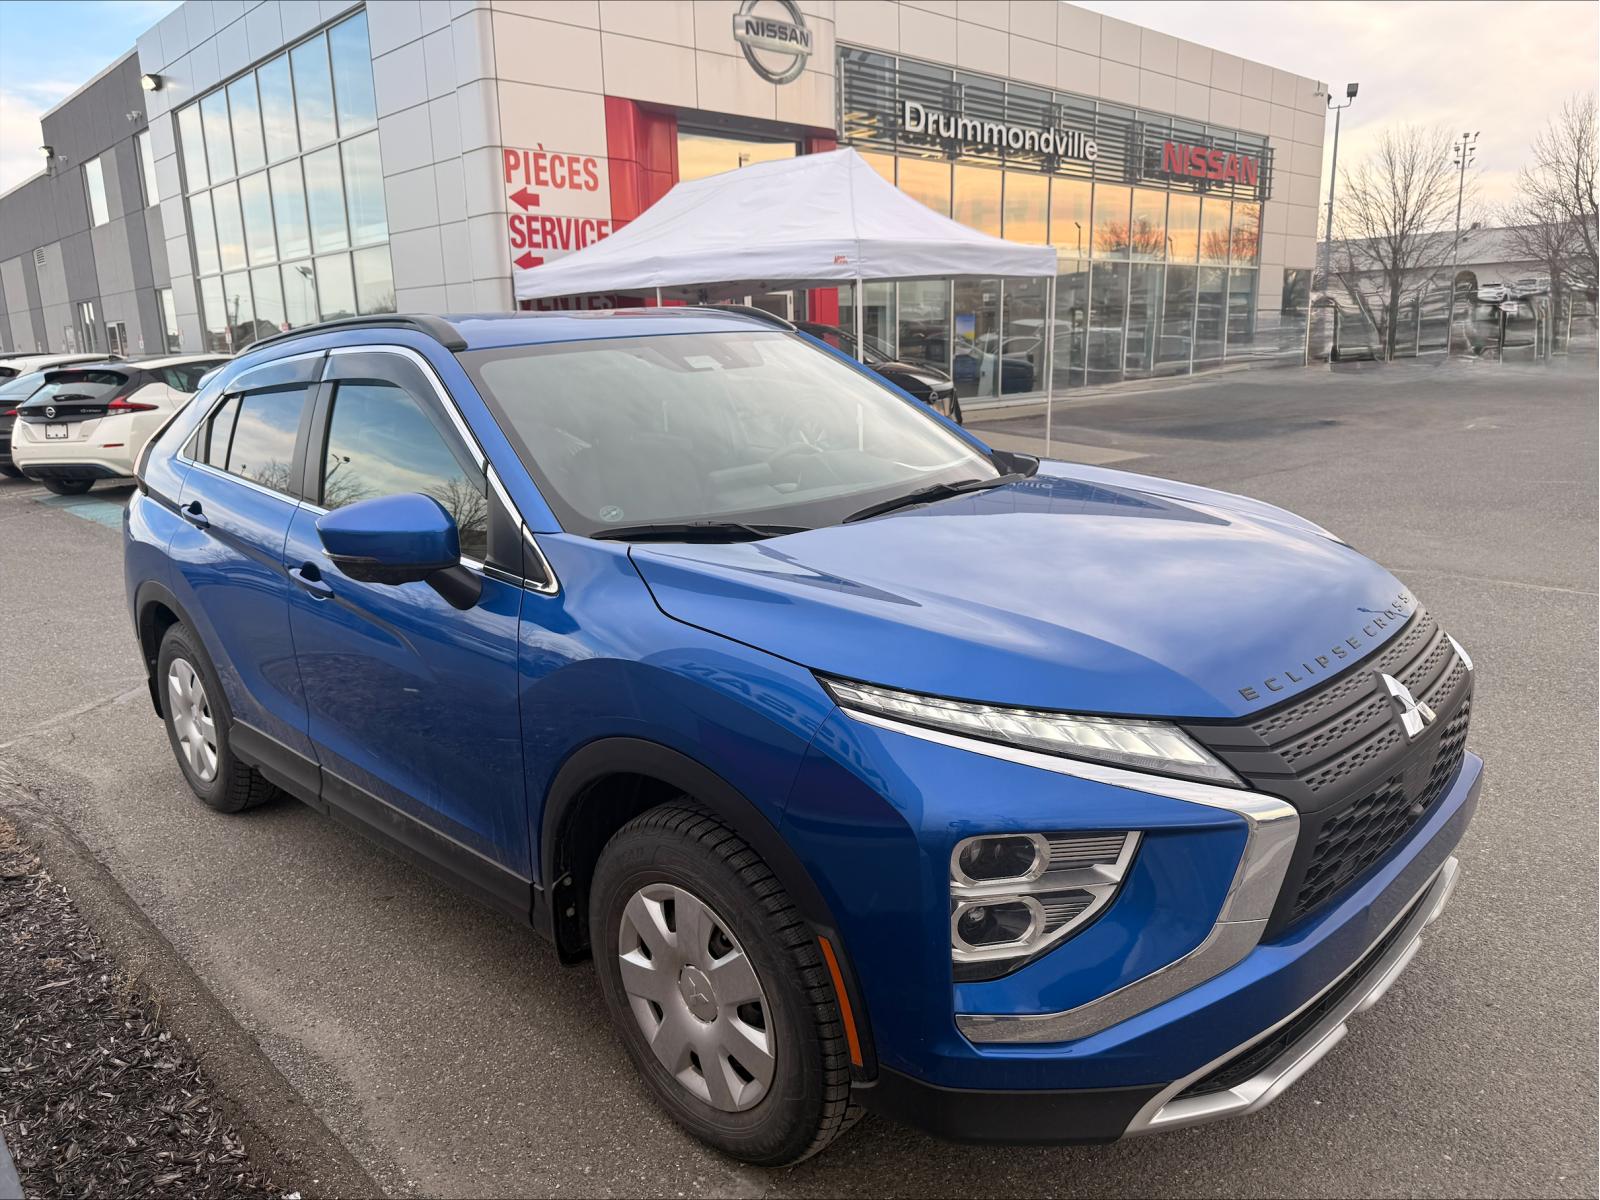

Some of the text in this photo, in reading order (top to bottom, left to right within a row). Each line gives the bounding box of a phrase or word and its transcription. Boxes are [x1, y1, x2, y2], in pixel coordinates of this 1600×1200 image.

[745, 20, 809, 47] NISSAN
[904, 101, 1099, 161] Drummondville
[503, 142, 600, 192] PIÈCES
[1163, 140, 1259, 186] NISSAN
[509, 214, 610, 251] SERVICE
[1237, 592, 1408, 702] ECLIPSE CROSS
